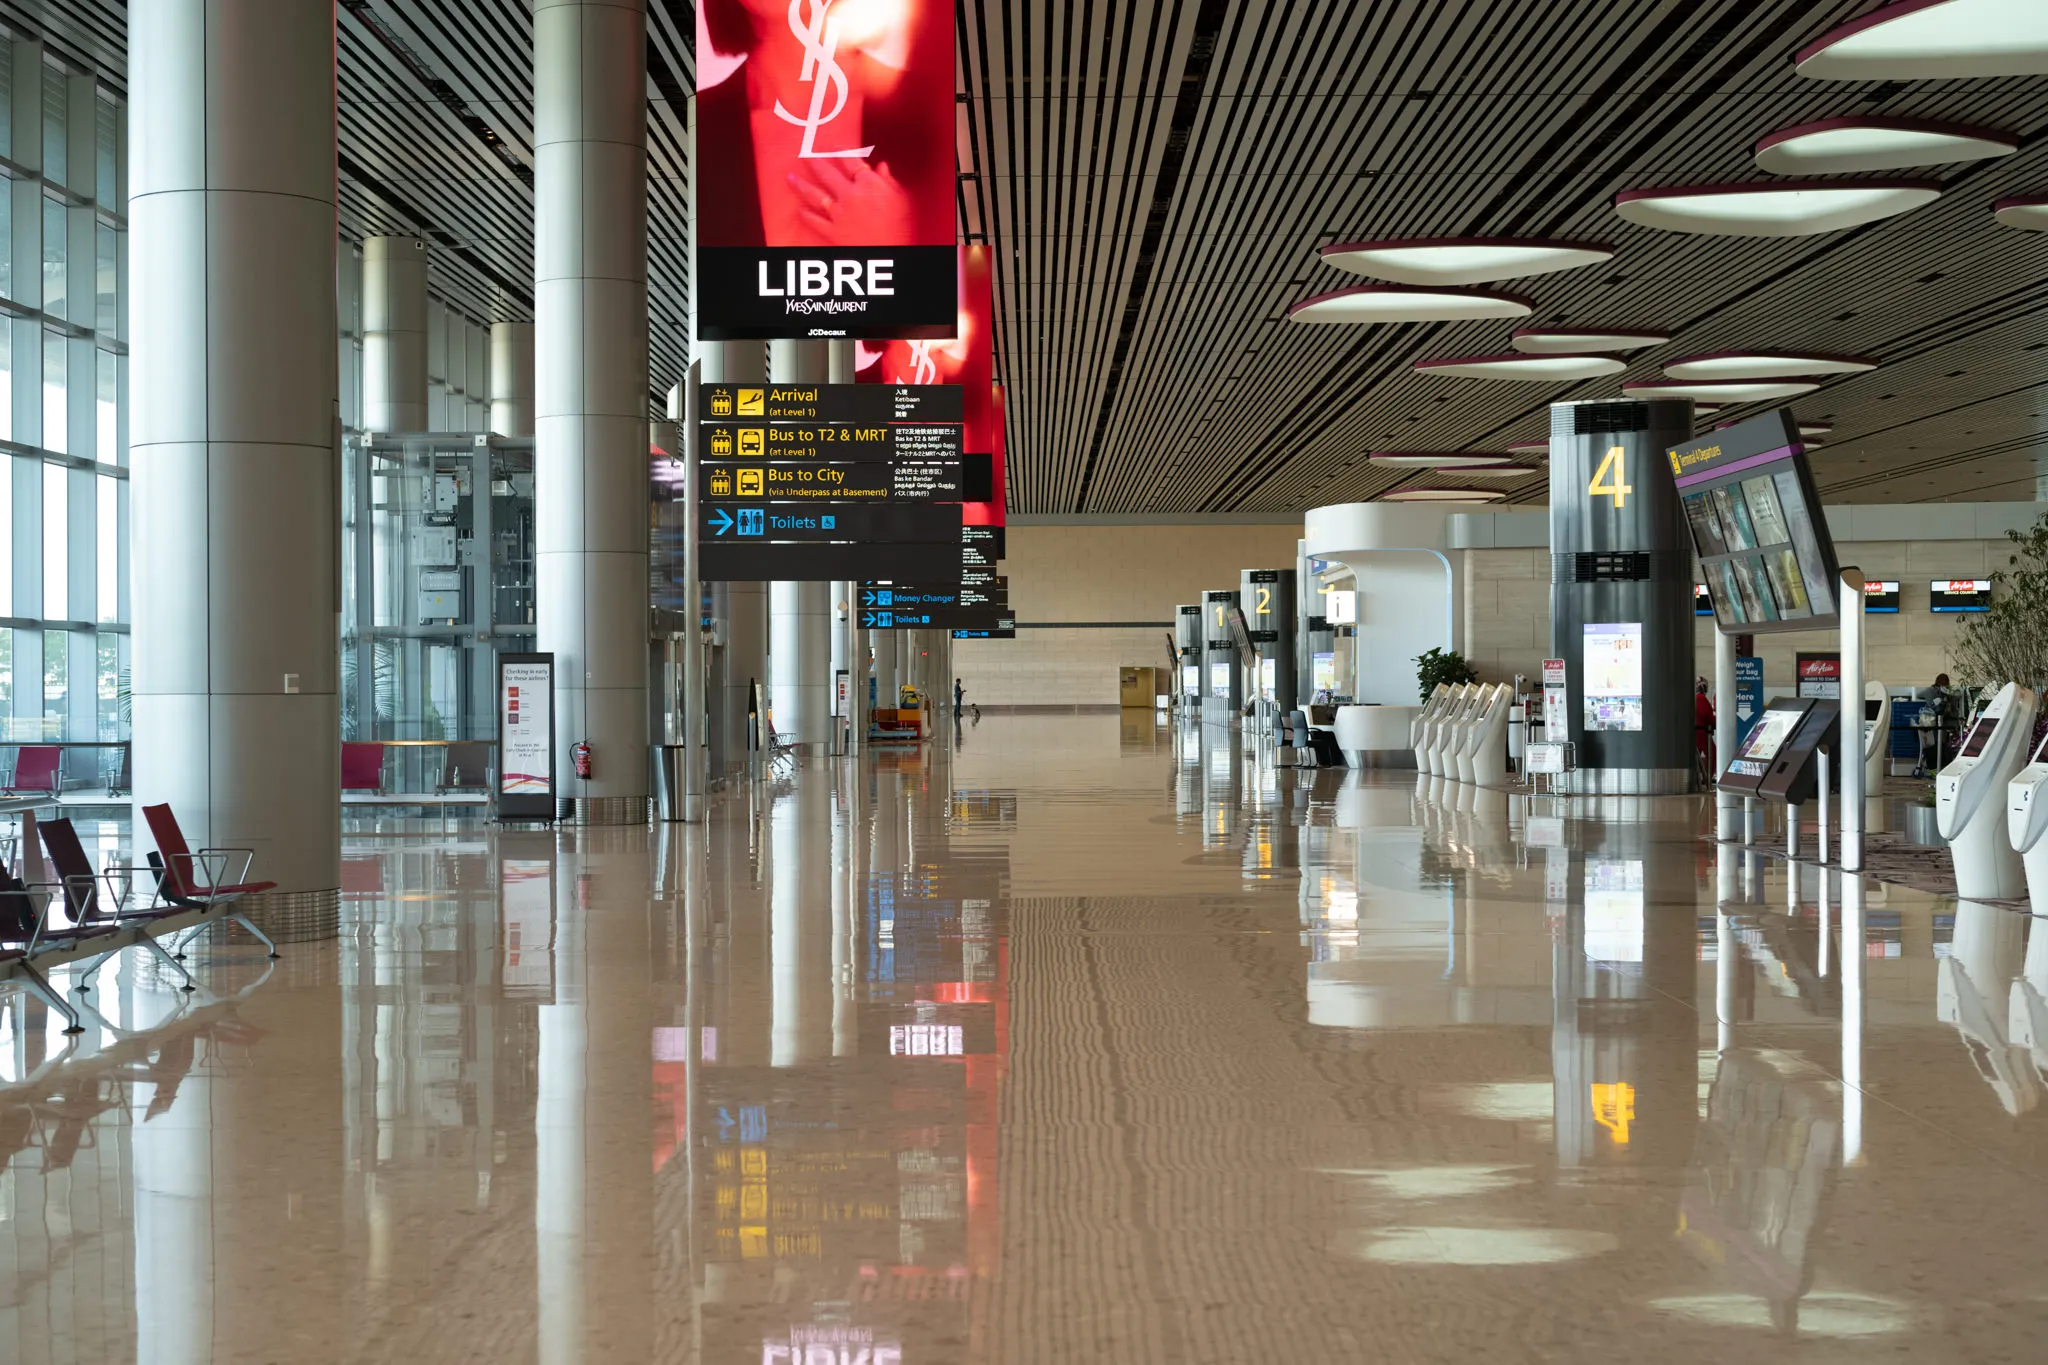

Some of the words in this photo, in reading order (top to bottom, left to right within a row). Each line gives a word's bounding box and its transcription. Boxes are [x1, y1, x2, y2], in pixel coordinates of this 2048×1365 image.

[759, 260, 894, 296] LIBRE
[769, 388, 818, 402] Arrival
[769, 408, 781, 416] (at
[783, 408, 806, 416] Level
[808, 408, 816, 416] 1)
[769, 428, 794, 441] Bus
[798, 430, 814, 441] to
[817, 428, 835, 441] T2
[839, 428, 851, 441] &
[855, 428, 888, 441] MRT
[769, 448, 781, 456] (at
[783, 448, 806, 456] Level
[808, 448, 816, 456] 1)
[768, 468, 793, 481] Bus
[797, 469, 813, 481] to
[817, 468, 845, 484] City
[1588, 446, 1632, 508] 4
[768, 487, 784, 497] (via
[786, 487, 830, 497] Underpass
[831, 488, 841, 496] at
[843, 487, 888, 497] Basement)
[770, 515, 816, 529] Toilets
[894, 595, 920, 604] Money
[922, 595, 955, 604] Changer
[1255, 588, 1271, 614] 2
[894, 615, 920, 623] Toilets
[1215, 605, 1223, 627] 1
[1806, 661, 1834, 675] AirAsia
[1736, 693, 1754, 701] Here
